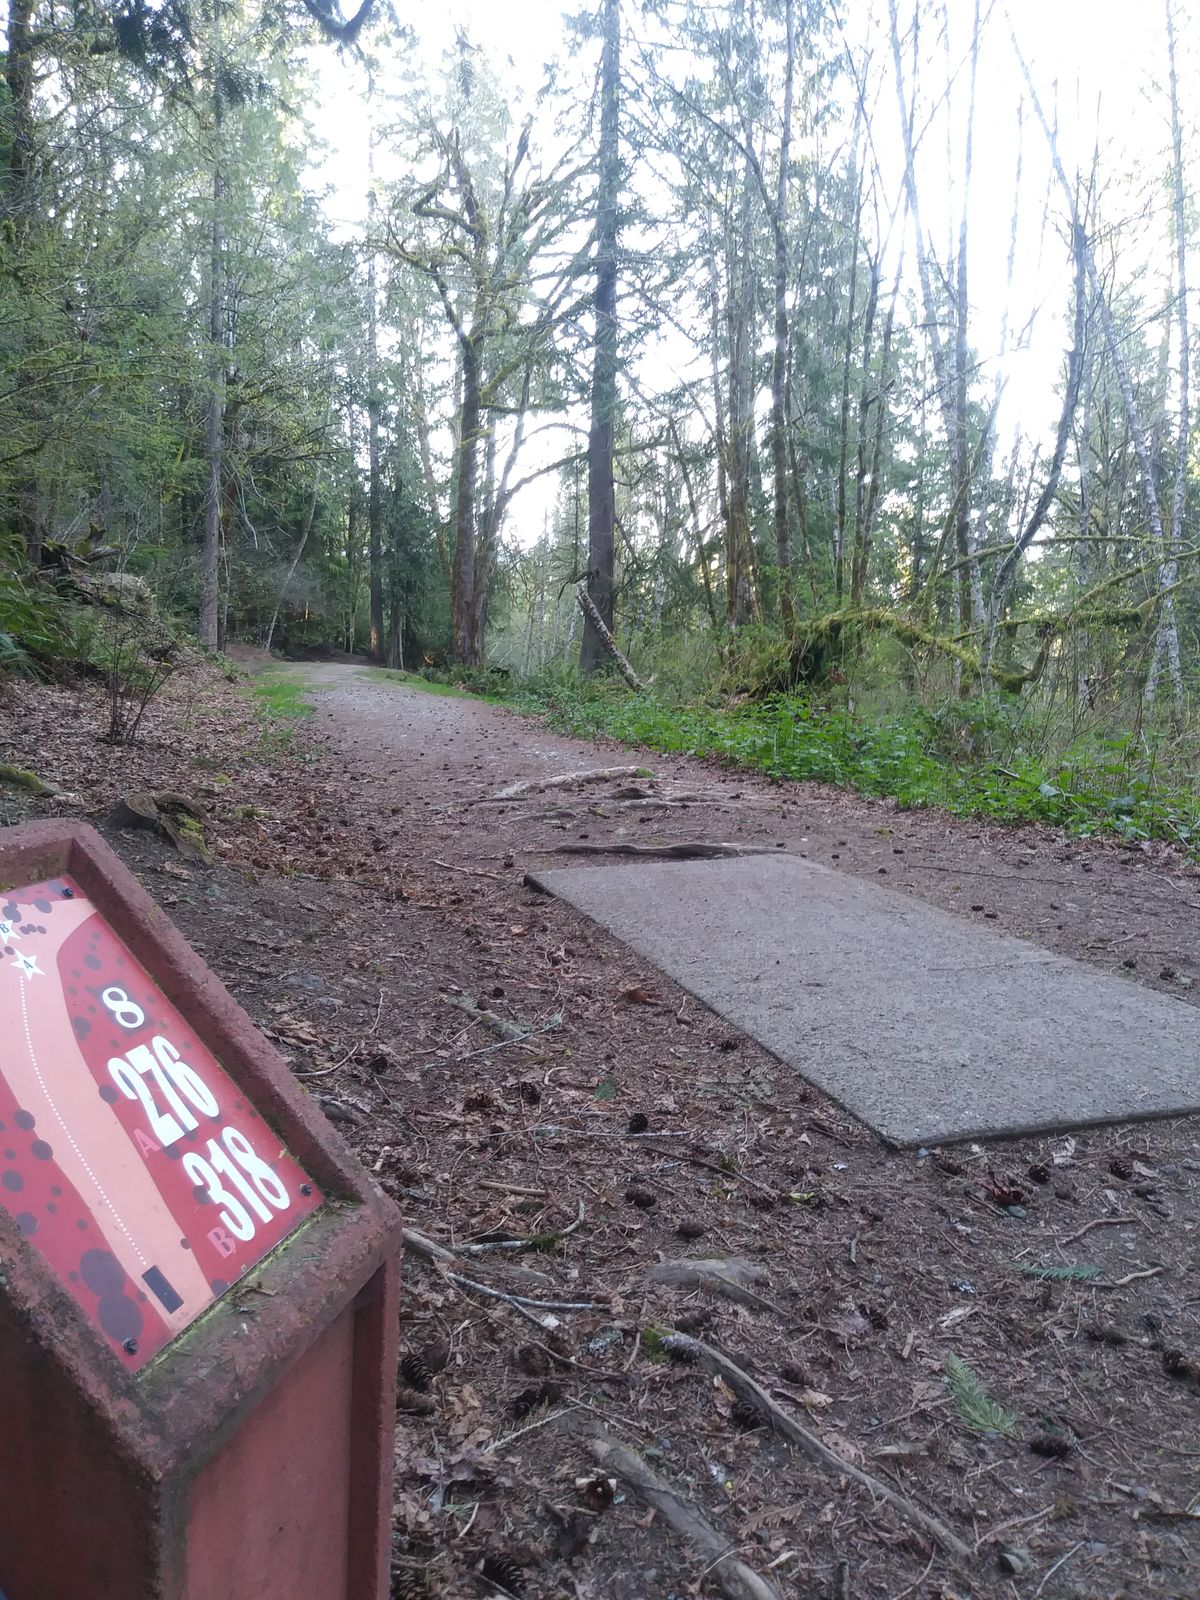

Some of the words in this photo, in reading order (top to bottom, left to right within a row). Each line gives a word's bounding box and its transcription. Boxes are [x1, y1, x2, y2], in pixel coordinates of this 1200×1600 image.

[23, 960, 34, 969] A
[102, 986, 145, 1028] 8
[107, 1035, 220, 1147] 276
[133, 1128, 161, 1158] A
[182, 1126, 291, 1241] 318
[207, 1226, 237, 1258] B
